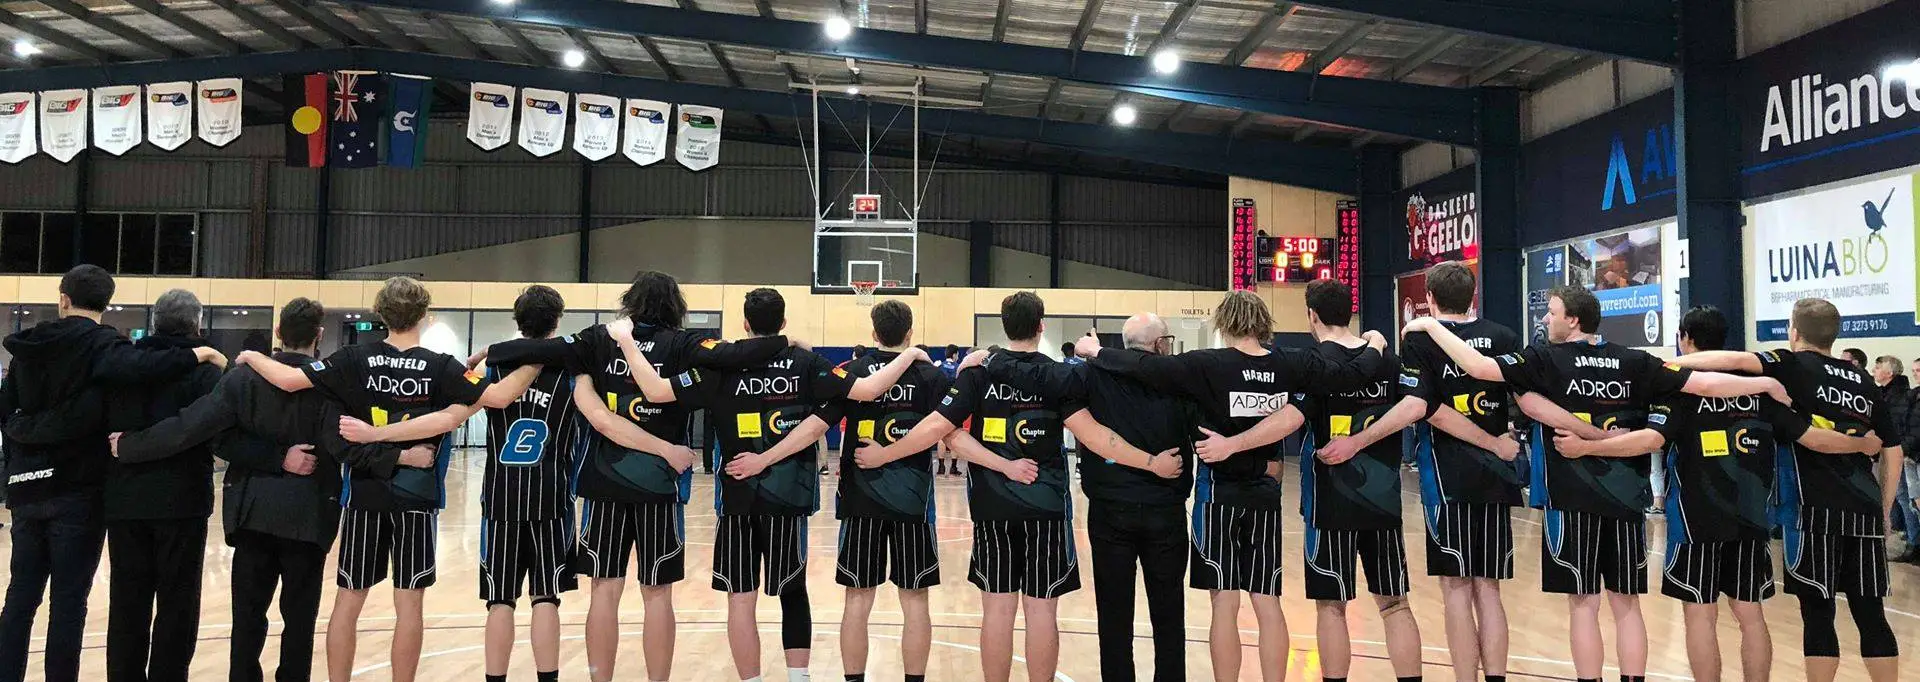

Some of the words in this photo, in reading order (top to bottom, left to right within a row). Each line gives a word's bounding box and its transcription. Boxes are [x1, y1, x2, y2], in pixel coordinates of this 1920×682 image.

[859, 200, 875, 211] 24
[1284, 239, 1318, 252] 5:00
[1843, 322, 1850, 331] 07
[1852, 320, 1868, 331] 3273
[1870, 319, 1888, 330] 9176
[636, 405, 662, 415] Chapter
[1021, 428, 1045, 437] Chapter
